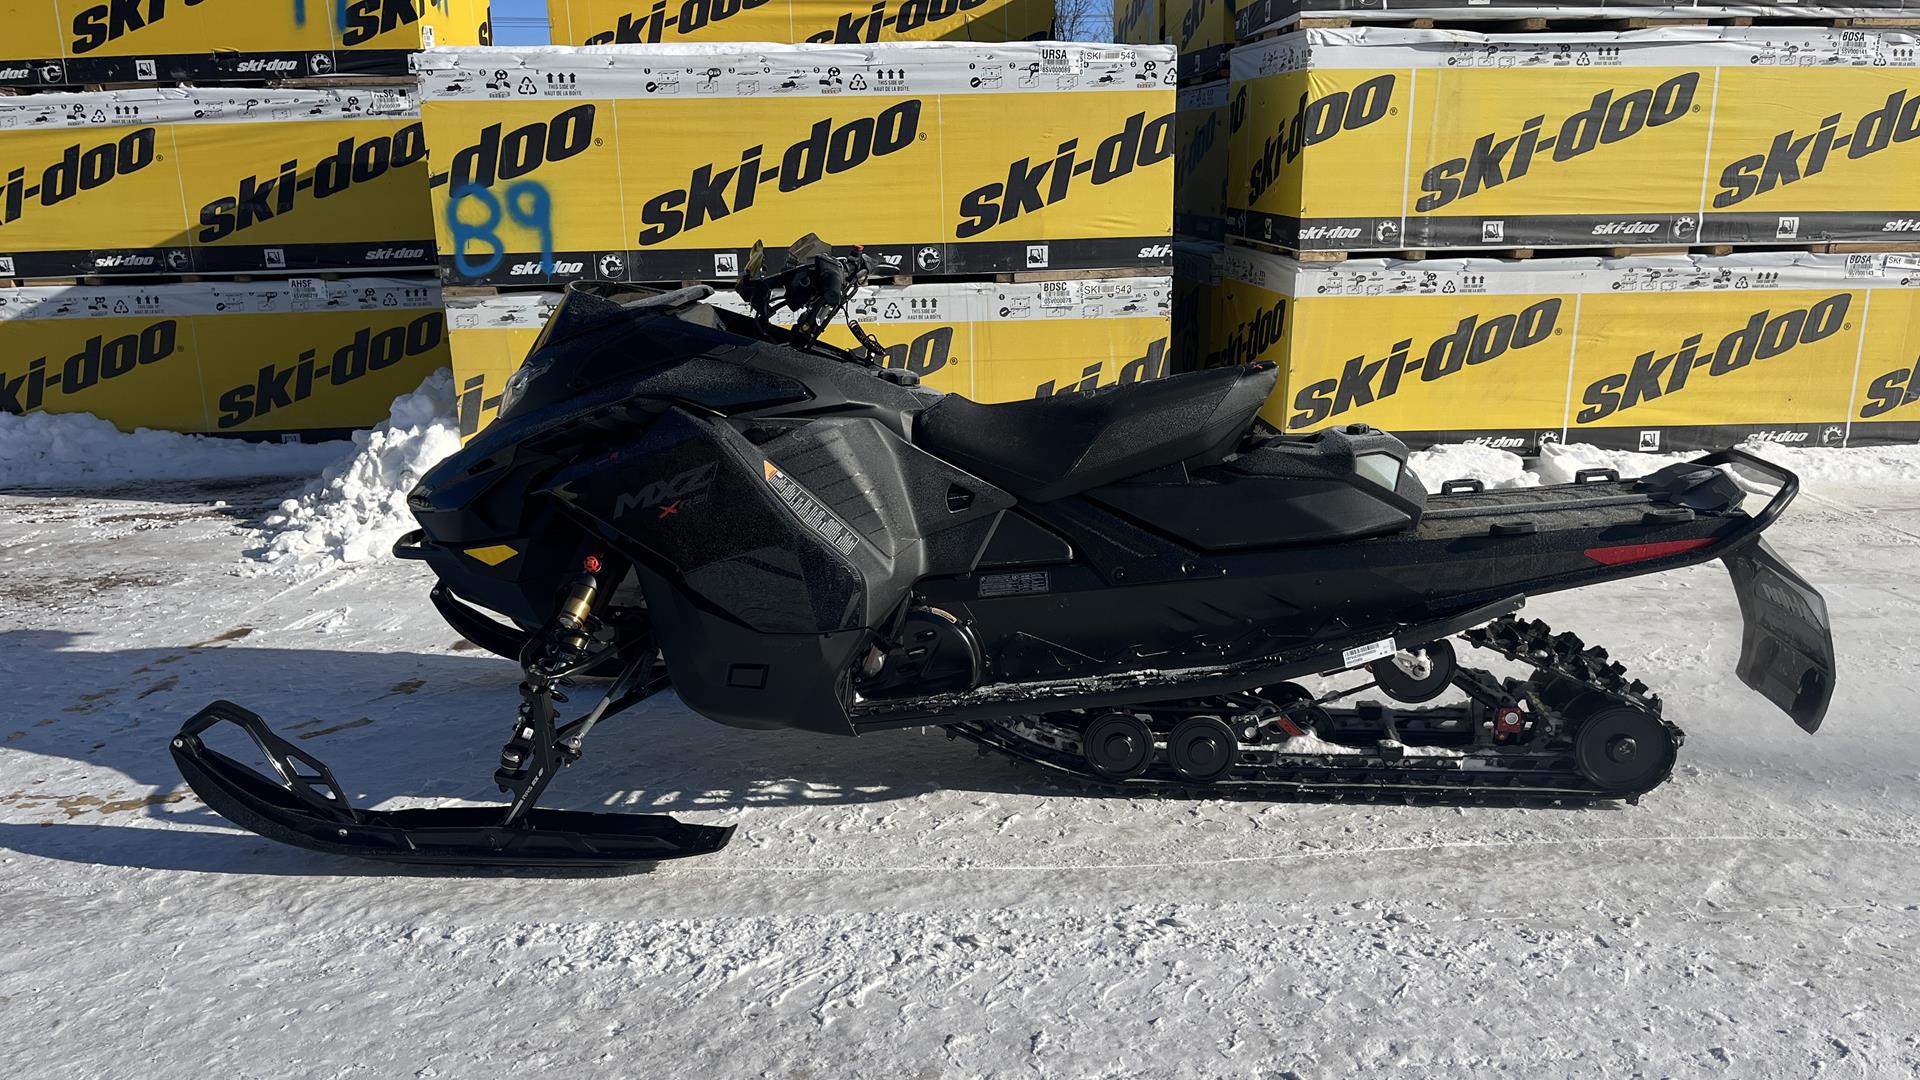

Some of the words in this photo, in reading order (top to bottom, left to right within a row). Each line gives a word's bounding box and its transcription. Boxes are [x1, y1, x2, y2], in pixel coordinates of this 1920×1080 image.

[1042, 49, 1067, 59] URSA
[1087, 51, 1101, 60] SKI
[237, 59, 297, 72] ski-doo
[1415, 72, 1700, 213] ski-doo
[0, 127, 155, 226] i-doo
[639, 99, 921, 246] ski-doo
[955, 111, 1175, 239] ski-do
[198, 121, 428, 243] ski-doo
[446, 179, 554, 277] 89
[1297, 226, 1362, 240] ski-doo
[1591, 222, 1660, 234] ski-doo
[365, 247, 424, 260] ski-doo
[1137, 244, 1173, 259] ski-
[95, 255, 154, 268] ski-doo
[510, 260, 584, 275] skidoo
[291, 280, 312, 288] AHSF
[1043, 282, 1067, 291] BDSC
[1084, 285, 1100, 295] SKI
[1288, 298, 1562, 429] ski-doo
[1576, 293, 1852, 424] ski-doo
[218, 312, 443, 428] ski-doo
[613, 461, 718, 520] MXZ
